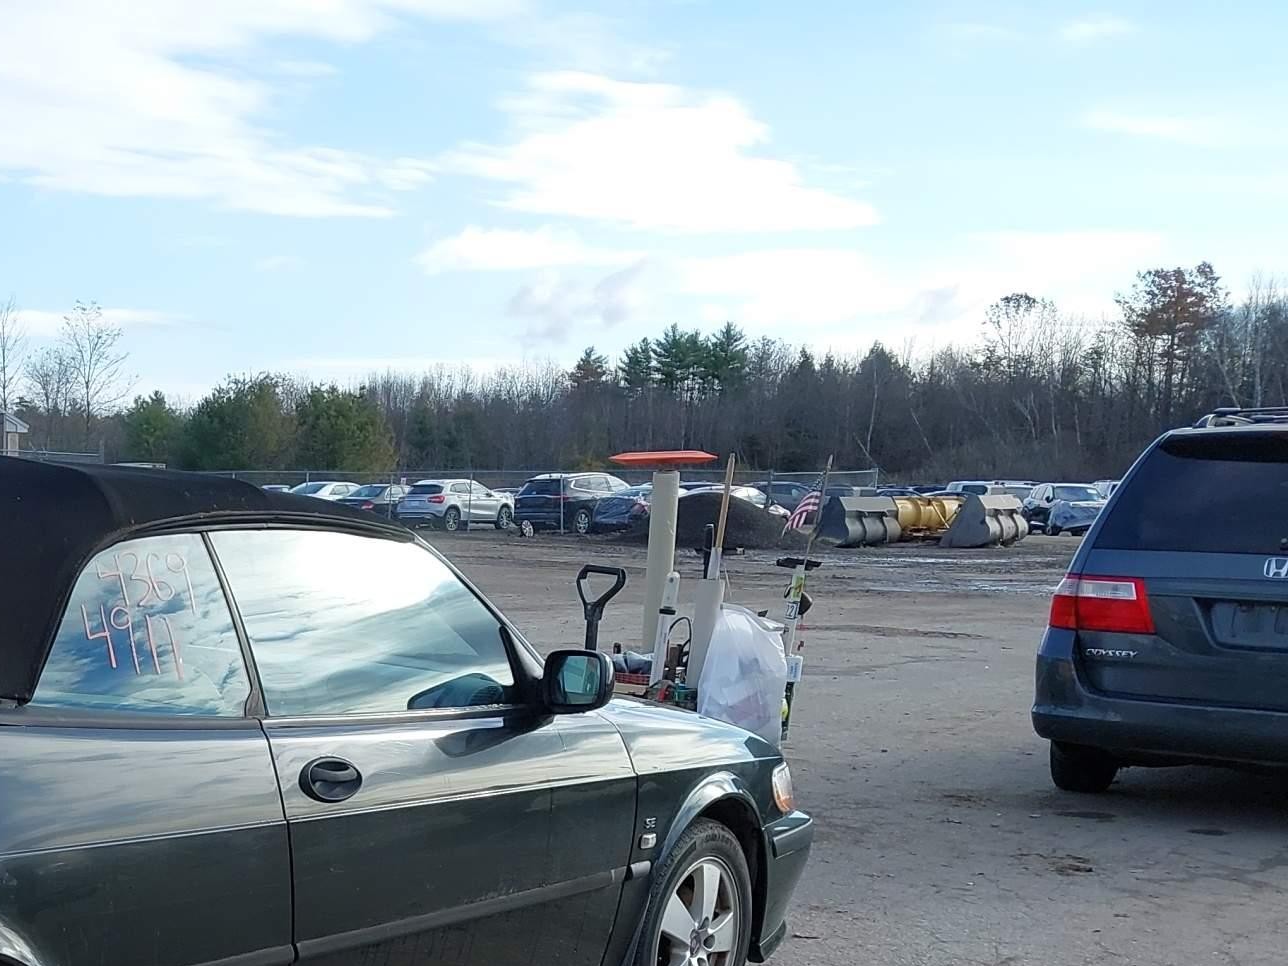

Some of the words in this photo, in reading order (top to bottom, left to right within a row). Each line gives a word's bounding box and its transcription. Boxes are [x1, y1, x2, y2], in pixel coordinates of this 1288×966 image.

[95, 552, 197, 615] 4369
[80, 602, 185, 681] 4911
[1086, 648, 1138, 659] ODYSSEY
[645, 817, 657, 829] SE
